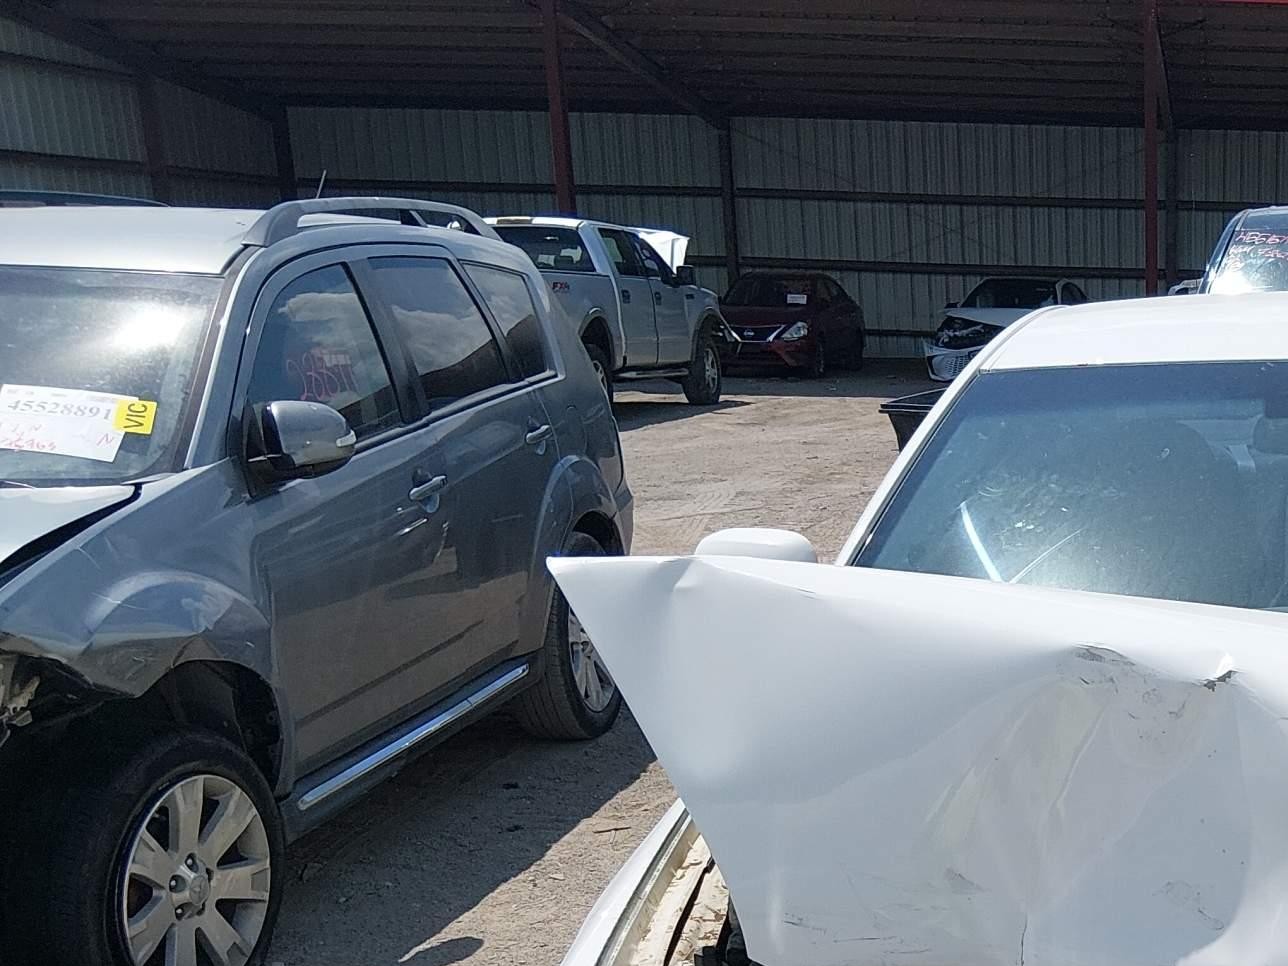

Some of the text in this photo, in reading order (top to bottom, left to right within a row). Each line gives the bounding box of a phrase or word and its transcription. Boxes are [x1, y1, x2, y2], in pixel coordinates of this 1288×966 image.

[552, 281, 570, 290] FX4
[7, 400, 112, 420] 45528891
[123, 402, 148, 429] VIC
